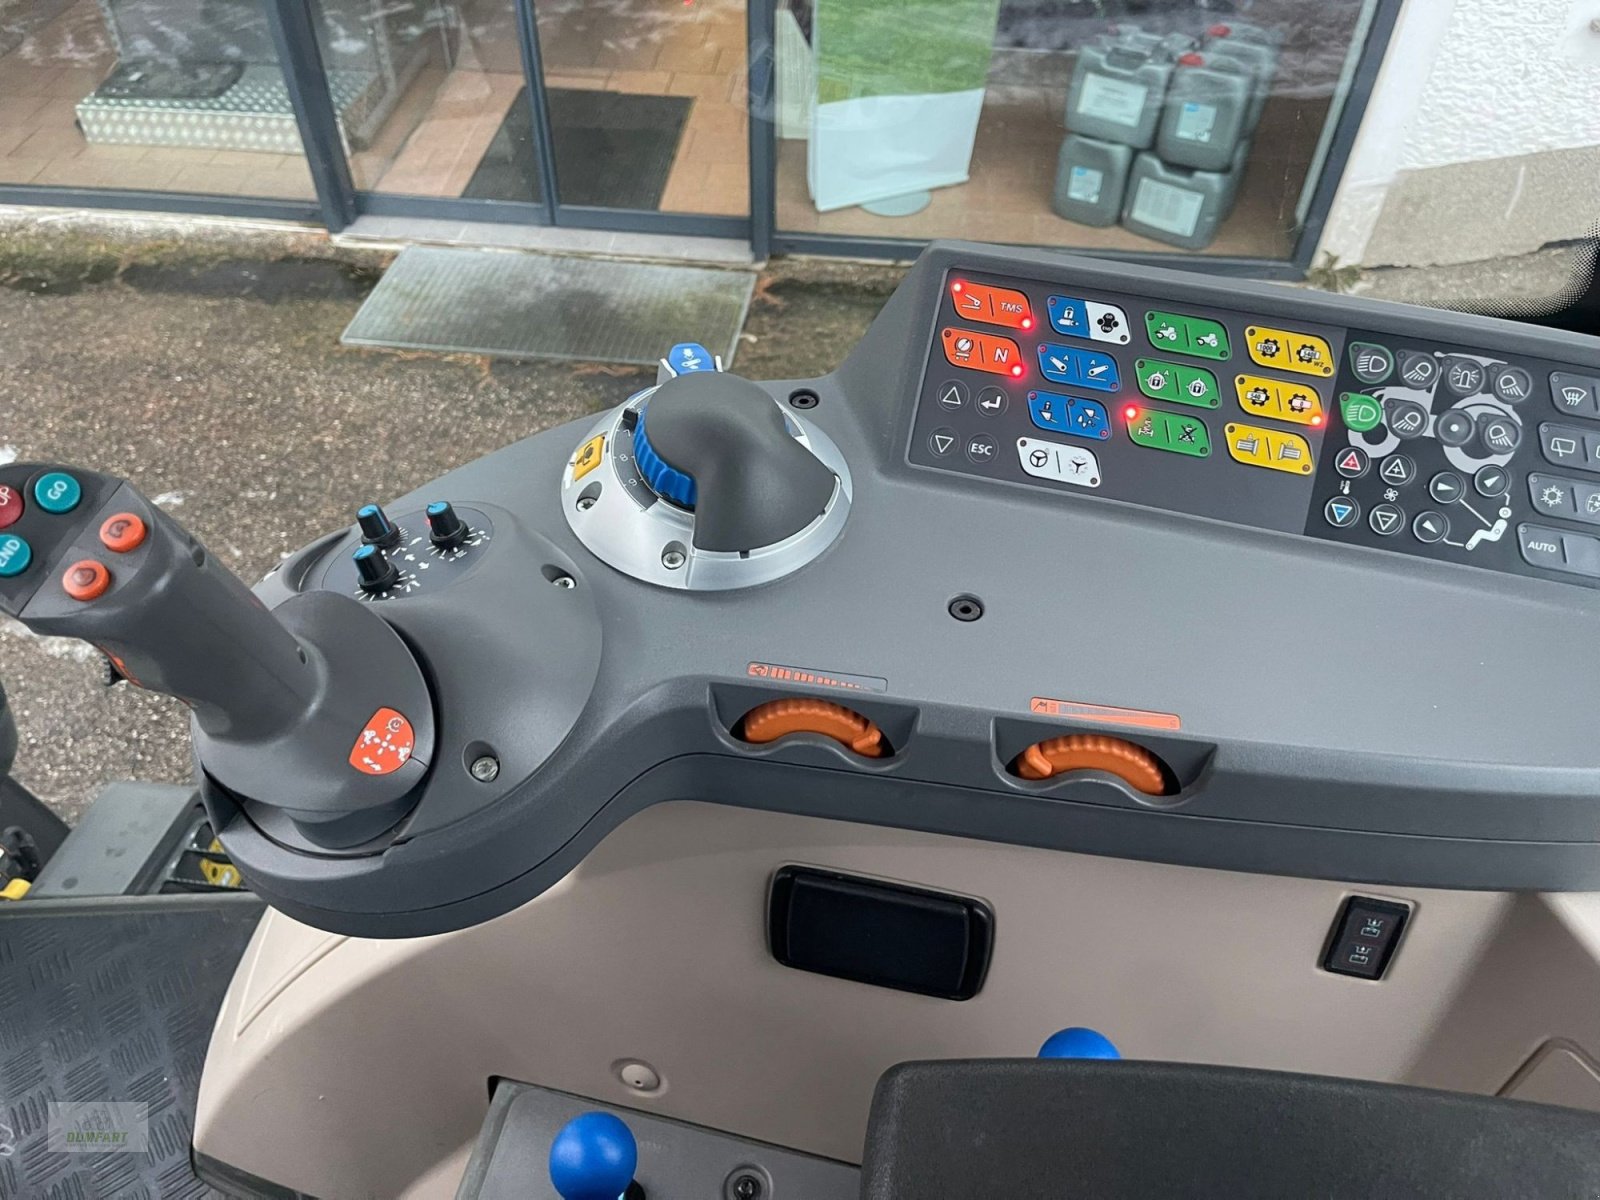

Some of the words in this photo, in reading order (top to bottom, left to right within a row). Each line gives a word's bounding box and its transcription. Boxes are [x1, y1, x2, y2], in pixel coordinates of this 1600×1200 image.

[1000, 302, 1023, 313] TMS
[993, 348, 1009, 363] N
[970, 443, 993, 456] ESC
[619, 453, 629, 462] 8
[47, 480, 68, 500] GO
[1527, 541, 1557, 552] AUTO
